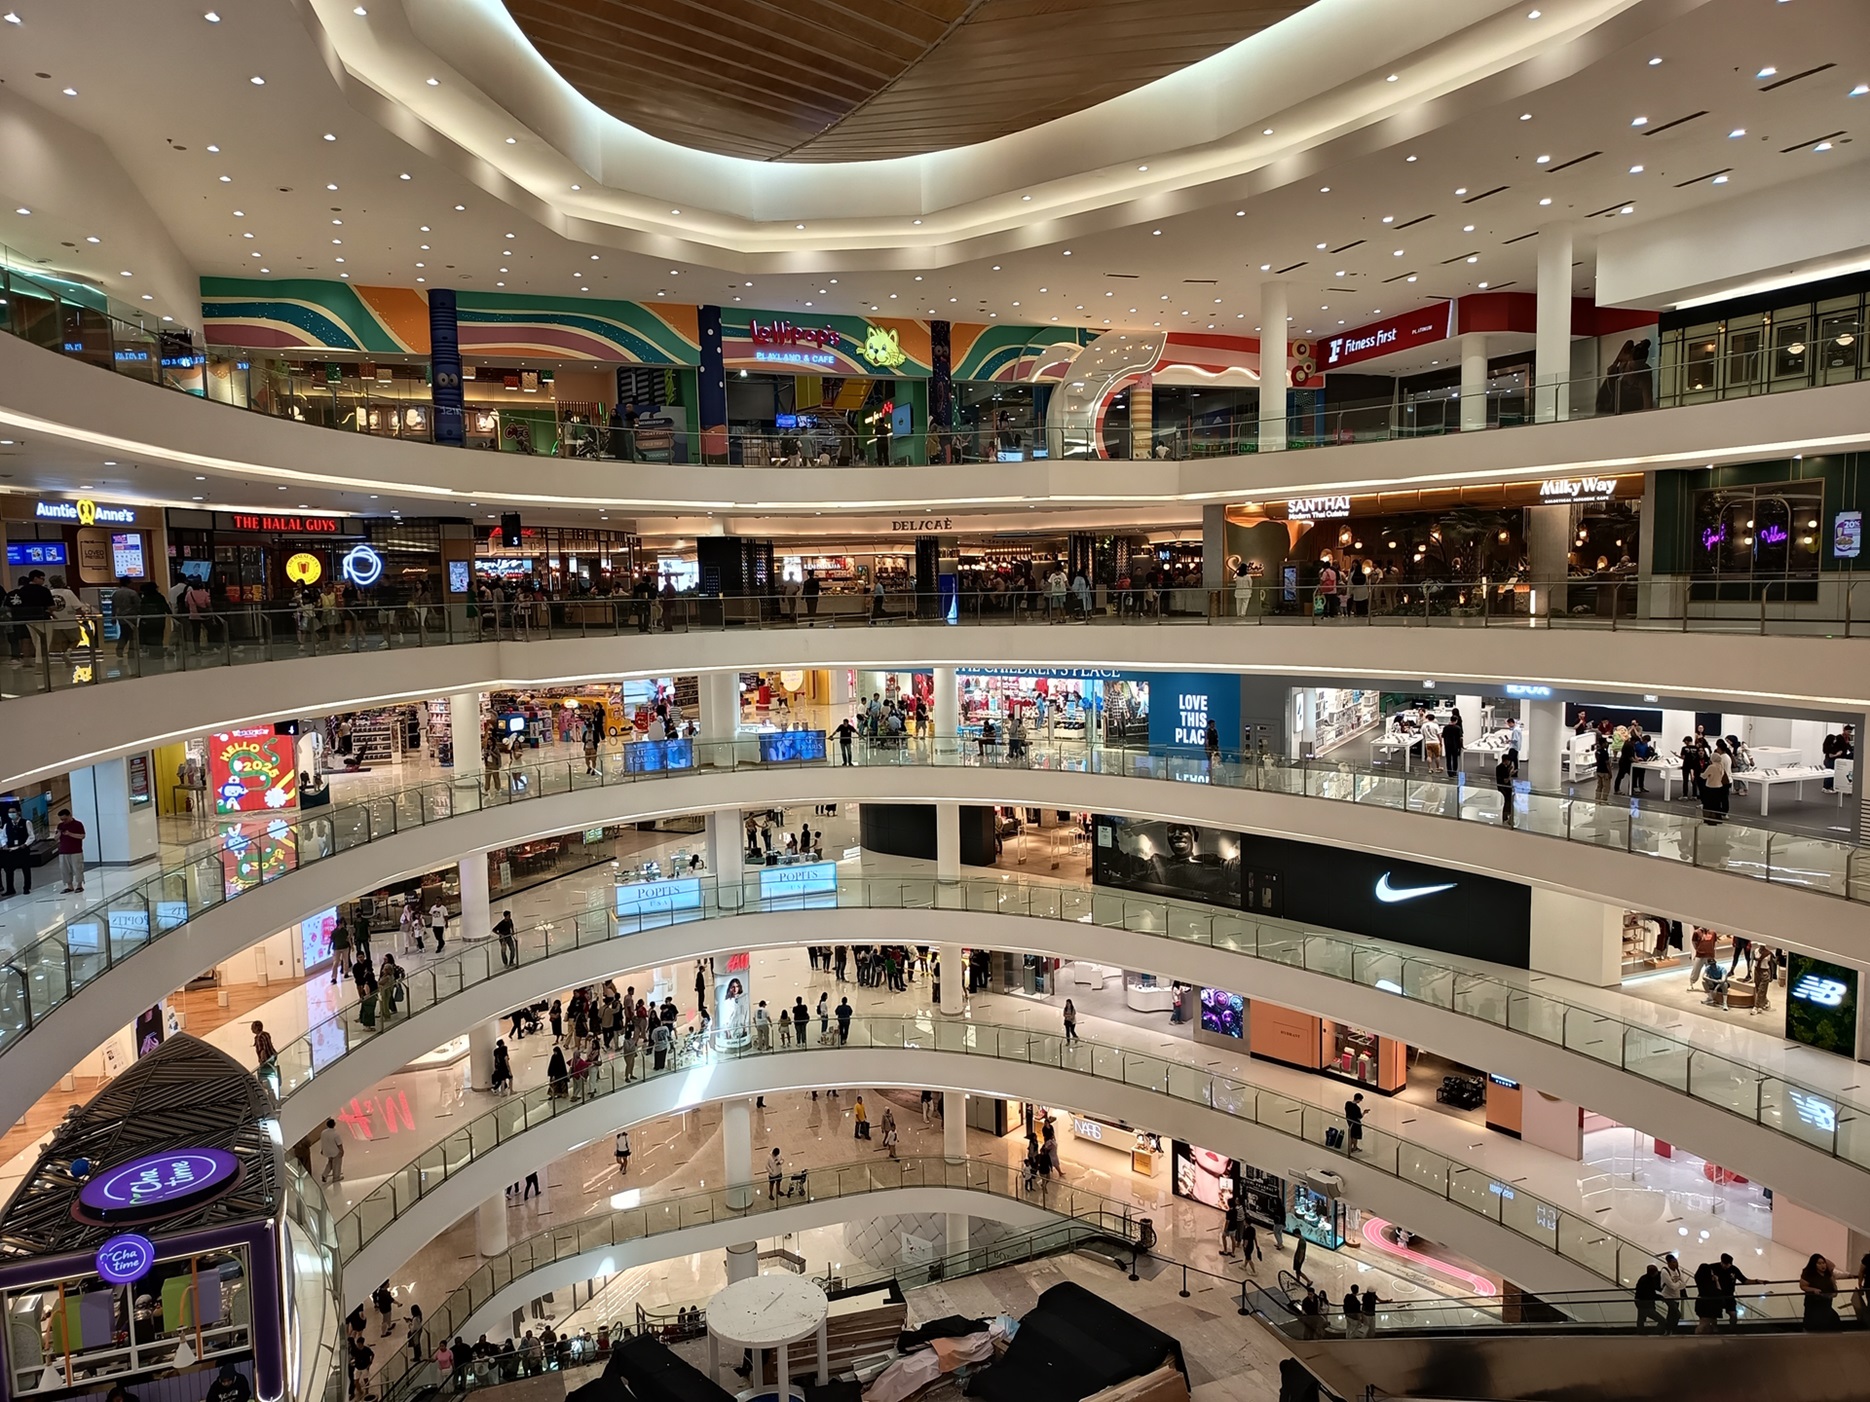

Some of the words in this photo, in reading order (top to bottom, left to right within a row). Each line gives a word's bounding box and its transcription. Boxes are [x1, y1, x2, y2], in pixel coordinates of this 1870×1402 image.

[750, 319, 840, 348] Lollipop's
[1344, 336, 1375, 355] Fitness
[1376, 329, 1397, 347] First
[756, 351, 801, 361] PLAYLAND
[812, 355, 835, 364] CAFE
[1540, 480, 1581, 496] Milky
[1581, 477, 1617, 494] Way
[36, 502, 77, 518] Auntie
[95, 507, 135, 522] Anne's
[1287, 496, 1351, 513] SANTHAI
[234, 515, 259, 529] THE
[263, 518, 303, 531] HALAL
[306, 520, 336, 532] GUYS
[1179, 694, 1208, 711] LOVE
[1180, 711, 1208, 728] THIS
[1175, 728, 1206, 745] PLAC
[220, 741, 260, 762] HELLO
[243, 761, 280, 778] 2025
[779, 870, 818, 882] POPITS
[637, 886, 680, 899] POPITS
[1074, 1119, 1102, 1140] NARS
[130, 1168, 163, 1193] Cha
[164, 1160, 195, 1187] time
[112, 1250, 138, 1262] Cha
[113, 1260, 140, 1272] time
